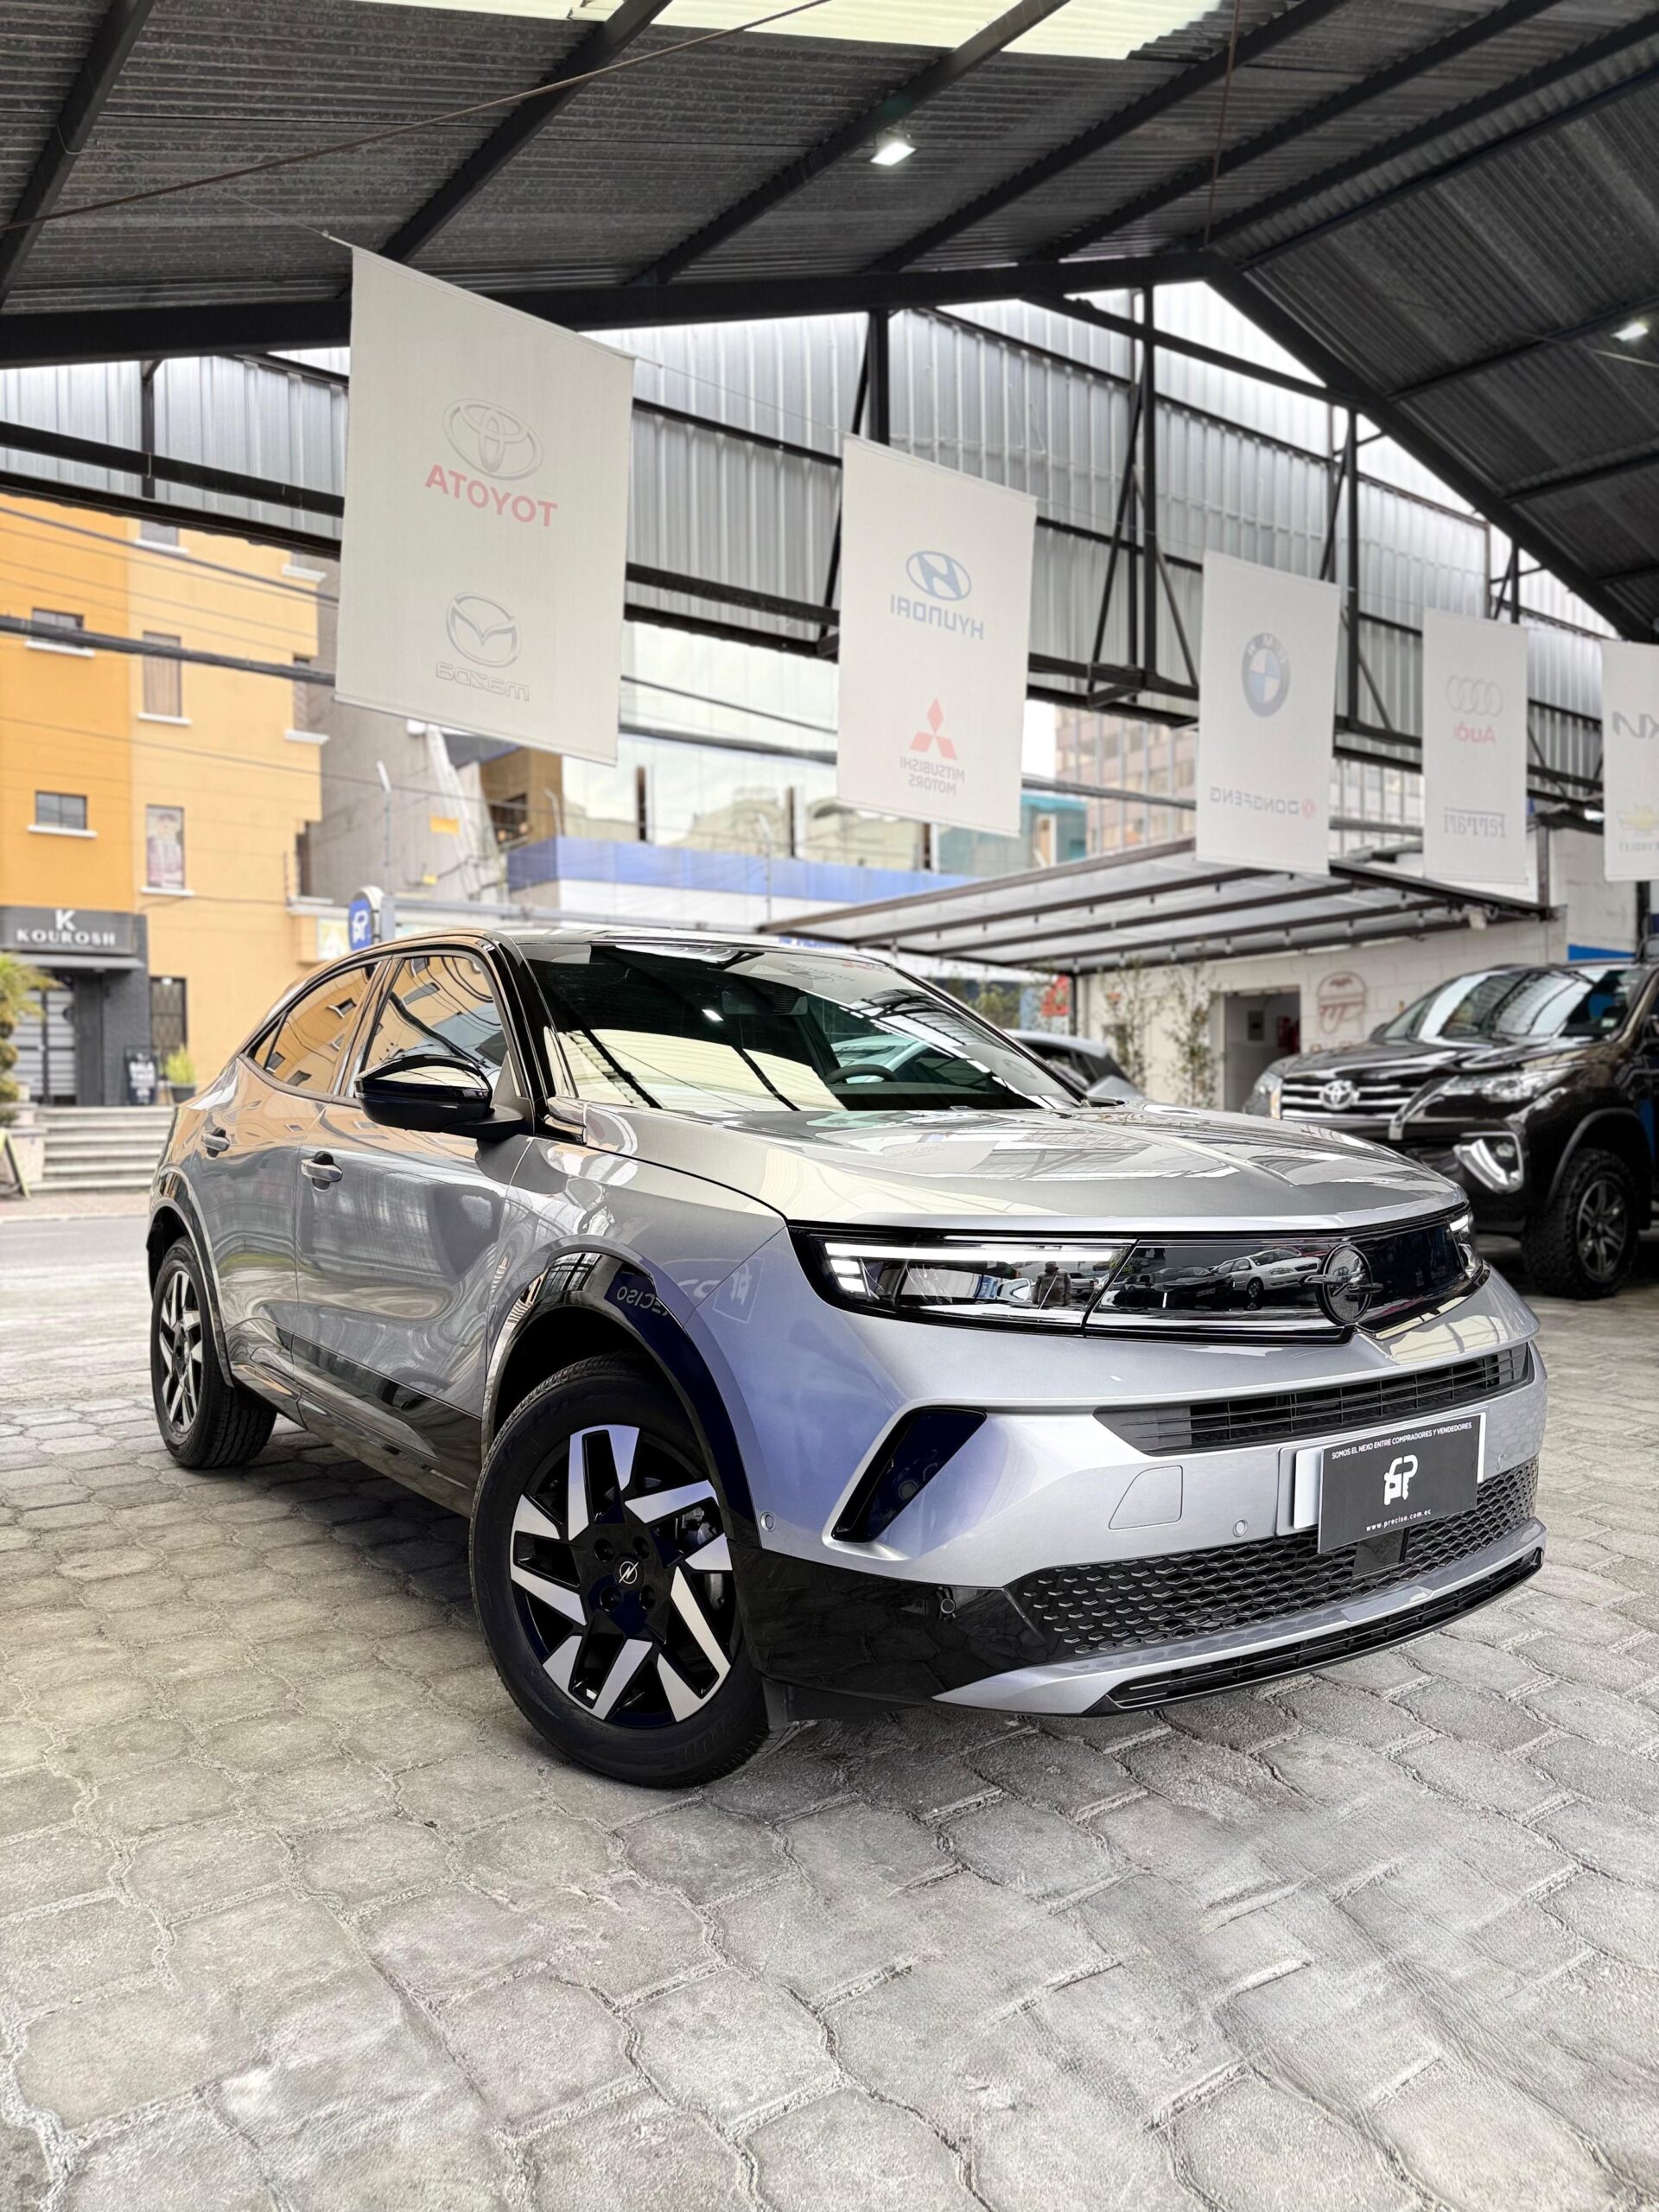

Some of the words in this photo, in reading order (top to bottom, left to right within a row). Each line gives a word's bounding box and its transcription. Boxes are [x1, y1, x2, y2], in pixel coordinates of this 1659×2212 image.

[55, 909, 76, 931] K
[16, 929, 116, 946] KOUROSH
[1332, 1448, 1351, 1459] SOMOS
[1351, 1446, 1358, 1455] EL
[1358, 1442, 1373, 1453] NEXO
[1373, 1438, 1392, 1450] ENTRE
[1391, 1430, 1433, 1445] COMPRADORES
[1437, 1421, 1472, 1435] VENDEDORES
